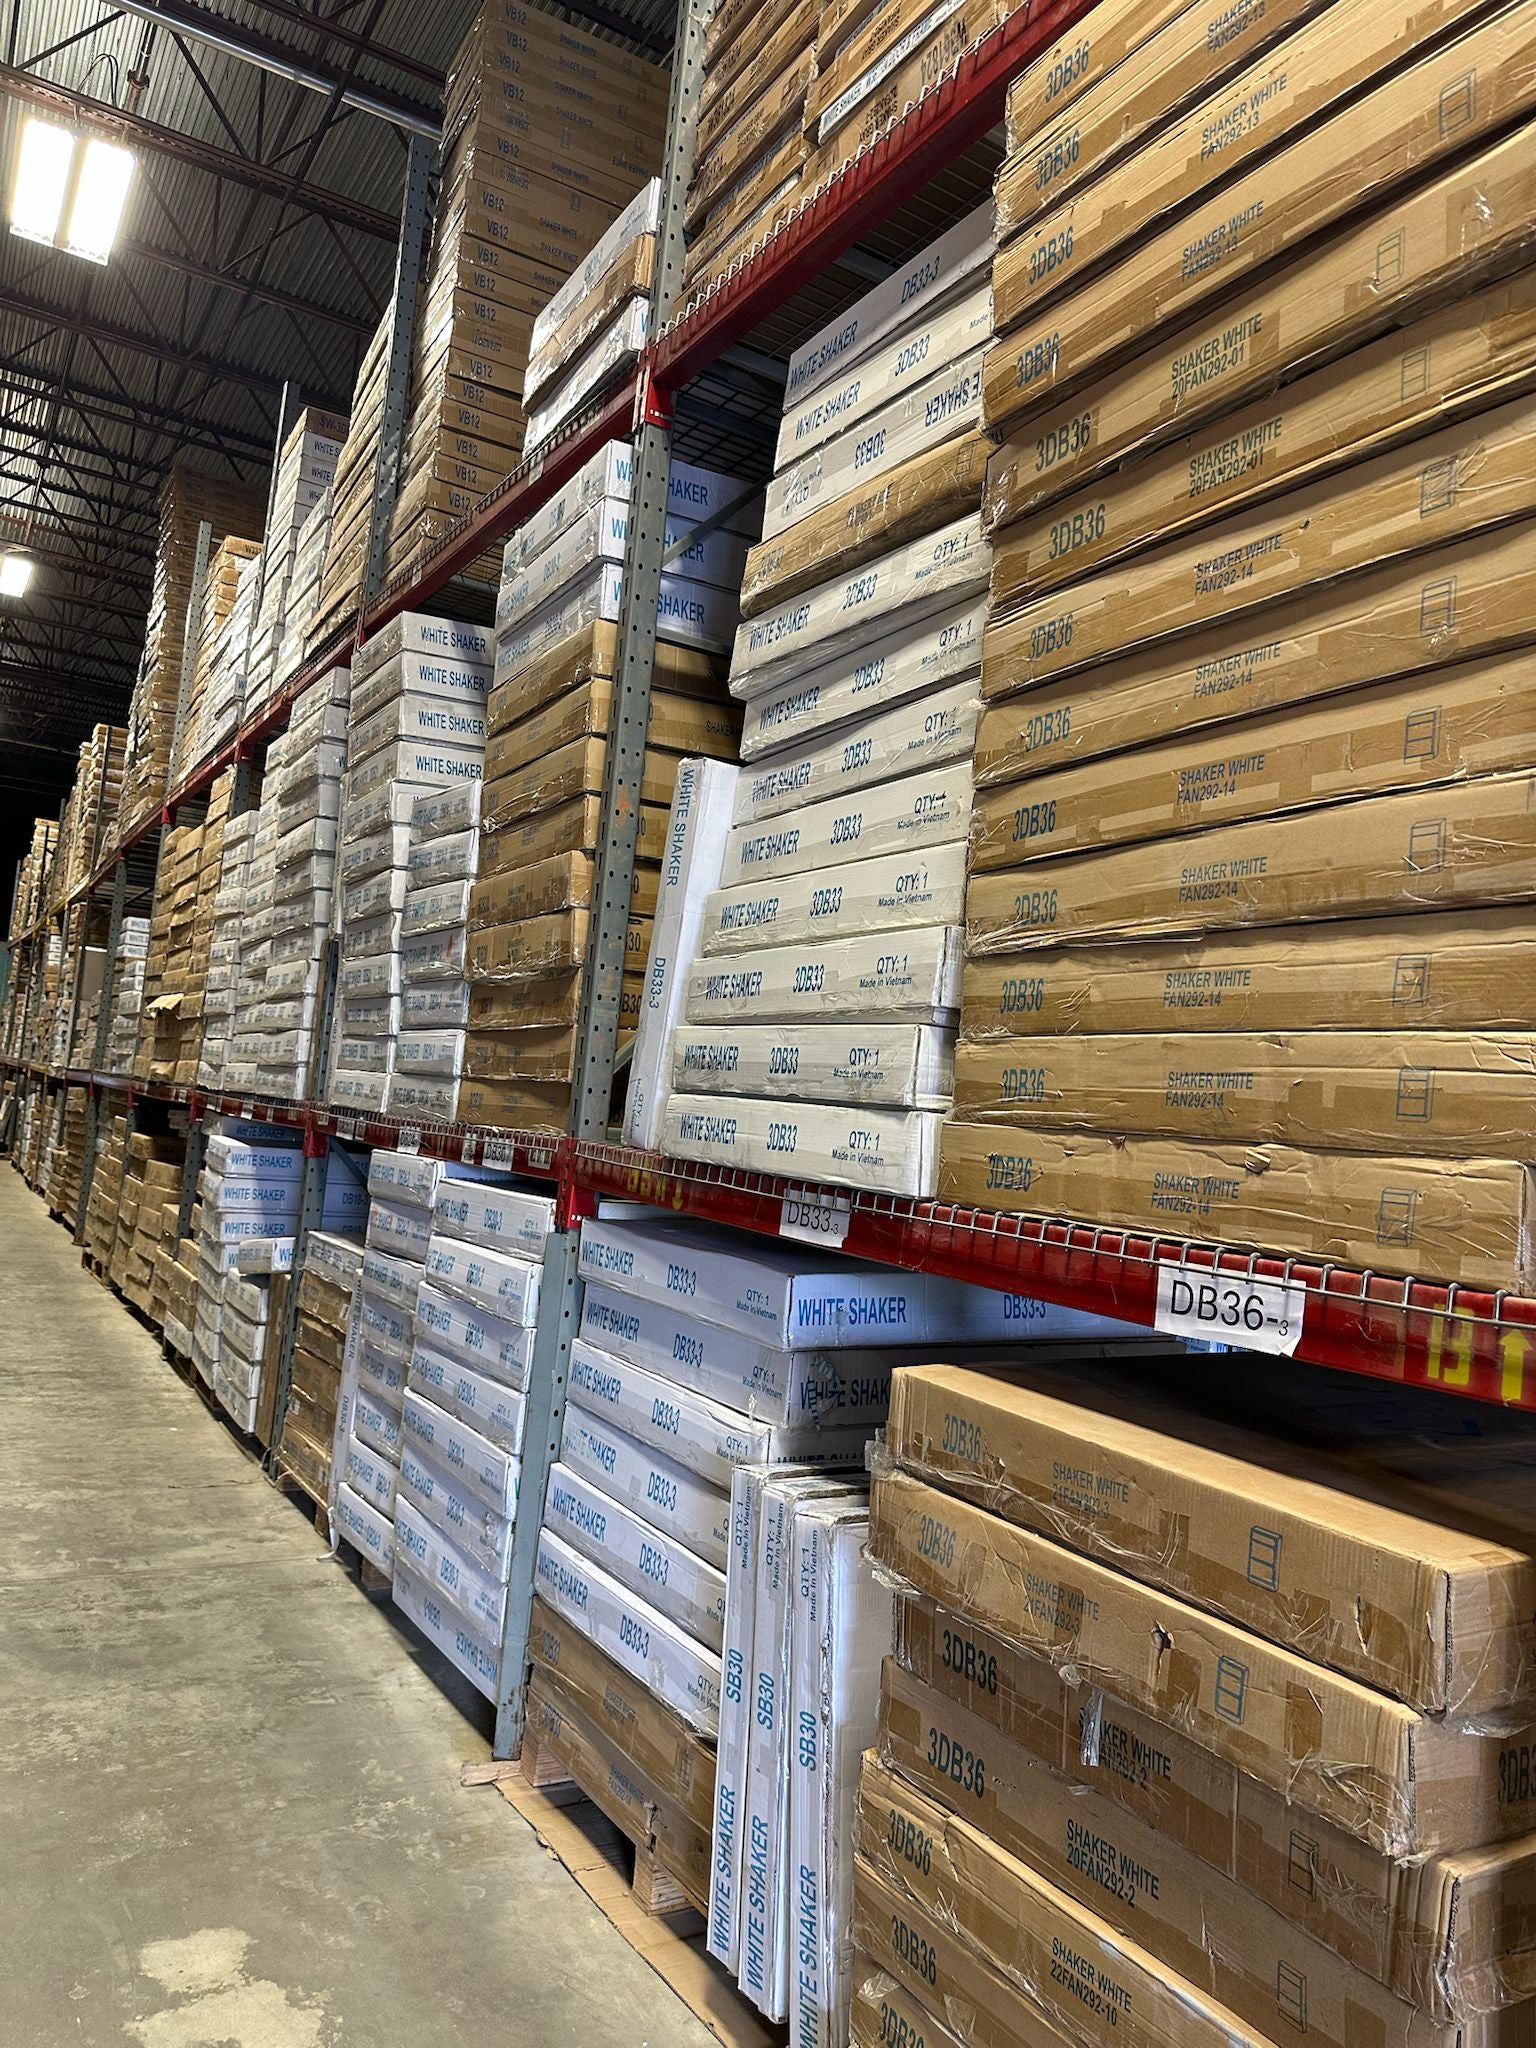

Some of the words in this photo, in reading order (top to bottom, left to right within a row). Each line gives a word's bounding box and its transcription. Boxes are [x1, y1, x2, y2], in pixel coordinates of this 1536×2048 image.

[505, 4, 528, 25] VB12
[1045, 41, 1090, 103] 3DB36
[502, 82, 525, 100] VB12
[1202, 103, 1247, 144] SHAKER
[1250, 74, 1287, 110] WHITE
[1200, 111, 1260, 161] FAN292-13
[487, 220, 509, 240] VB12
[477, 246, 499, 265] VB12
[1029, 226, 1074, 285] 3DB36
[473, 272, 496, 293] VB12
[901, 255, 940, 305] DB33-3
[790, 351, 819, 389] WHITE
[819, 320, 858, 370] SHAKER
[894, 334, 930, 377] 3DB33
[1172, 338, 1220, 379] SHAKER
[1223, 312, 1262, 350] WHITE
[470, 360, 493, 378] VB12
[463, 384, 485, 403] VB12
[314, 440, 334, 456] WHITE
[456, 439, 478, 457] VB12
[1035, 412, 1092, 472] 3DB36
[1189, 440, 1239, 478] SHAKER
[1241, 417, 1283, 452] WHITE
[1189, 449, 1265, 498] 20FAN292-01
[1049, 503, 1106, 559] 3DB36
[1196, 547, 1244, 579] SHAKER
[1245, 533, 1282, 560] WHITE
[1195, 563, 1254, 596] FAN292-14
[420, 626, 448, 646] WHITE
[450, 632, 486, 653] SHAKER
[419, 665, 446, 684] WHITE
[449, 671, 485, 692] SHAKER
[1194, 669, 1253, 700] FAN292-14
[418, 711, 446, 729] WHITE
[448, 716, 484, 736] SHAKER
[1026, 705, 1071, 753] 3DB36
[415, 755, 444, 774] WHITE
[446, 759, 482, 779] SHAKER
[1178, 761, 1225, 786] SHAKER
[1228, 754, 1265, 776] WHITE
[676, 769, 694, 819] WHITE
[830, 813, 862, 845] 3DB33
[1012, 800, 1057, 842] 3DB36
[666, 823, 686, 886] SHAKER
[1180, 861, 1227, 885] SHAKER
[1230, 856, 1268, 878] WHITE
[809, 886, 843, 917] 3DB33
[1178, 881, 1238, 904] FAN292-14
[721, 905, 745, 929] WHITE
[746, 897, 779, 926] SHAKER
[649, 957, 666, 1010] DB33-3
[792, 964, 825, 993] 3DB33
[859, 978, 876, 988] Made
[885, 975, 912, 987] Vietnam
[876, 957, 900, 975] QTY:
[1165, 971, 1210, 989] SHAKER
[1213, 970, 1251, 987] WHITE
[706, 976, 730, 999] WHITE
[731, 971, 763, 998] SHAKER
[1000, 978, 1045, 1014] 3DB36
[684, 1045, 706, 1069] WHITE
[707, 1045, 739, 1072] SHAKER
[769, 1047, 799, 1075] 3DB33
[1000, 1068, 1045, 1103] 3DB36
[1167, 1071, 1213, 1089] SHAKER
[1216, 1072, 1254, 1091] WHITE
[1165, 1091, 1225, 1109] FAN292-14
[680, 1114, 704, 1139] WHITE
[705, 1117, 737, 1145] SHAKER
[767, 1123, 798, 1153] 3DB33
[848, 1130, 871, 1150] QTY:
[232, 1153, 257, 1167] WHITE
[258, 1154, 292, 1169] SHAKER
[832, 1149, 848, 1161] Made
[857, 1153, 884, 1166] Vietnam
[224, 1187, 250, 1200] WHITE
[251, 1187, 286, 1201] SHAKER
[224, 1222, 250, 1235] WHITE
[251, 1222, 285, 1235] SHAKER
[787, 1203, 839, 1235] DB33-3
[582, 1240, 604, 1262] WHITE
[604, 1246, 634, 1276] SHAKER
[667, 1263, 696, 1296] DB33-3
[747, 1289, 764, 1304] QTY:
[586, 1301, 608, 1324] WHITE
[609, 1310, 640, 1342] SHAKER
[848, 1296, 907, 1325] SHAKER
[1170, 1280, 1289, 1336] DB36-3
[673, 1333, 704, 1368] DB33-3
[753, 1365, 769, 1382] QTY:
[850, 1376, 890, 1406] SHAK
[652, 1398, 680, 1435] DB33-3
[942, 1413, 982, 1463] 3DB36
[647, 1472, 677, 1512] DB33-3
[1052, 1462, 1093, 1489] SHAKER
[1096, 1476, 1129, 1503] WHITE
[553, 1486, 575, 1519] WHITE
[575, 1500, 606, 1542] SHAKER
[743, 1486, 751, 1527] Vietnam
[735, 1513, 744, 1546] QTY:
[917, 1515, 956, 1568] 3DB36
[639, 1543, 670, 1586] DB33-3
[801, 1560, 809, 1597] QTY:
[1023, 1596, 1080, 1635] 21FAN292-3
[1025, 1573, 1064, 1604] SHAKER
[1067, 1590, 1100, 1621] WHITE
[619, 1614, 650, 1659] DB33-3
[726, 1648, 744, 1703] SB30
[941, 1629, 998, 1696] 3DB36
[757, 1672, 775, 1731] SB30
[800, 1711, 817, 1772] SB30
[1131, 1736, 1171, 1781] WHITE
[928, 1727, 985, 1798] 3DB36
[716, 1784, 736, 1879] SHAKER
[887, 1809, 932, 1876] 3DB36
[749, 1815, 769, 1914] SHAKER
[1066, 1843, 1135, 1908] 20FAN292-2
[1067, 1818, 1117, 1865] SHAKER
[1120, 1853, 1159, 1900] WHITE
[713, 1878, 731, 1952] WHITE
[799, 1864, 817, 1971] SHAKER
[747, 1911, 764, 1991] WHITE
[891, 1914, 936, 1986] 3DB36
[1052, 1936, 1095, 1983] SHAKER
[1097, 1971, 1132, 2013] WHITE
[799, 1970, 818, 2048] WHITE
[1050, 1961, 1117, 2026] 22FAN292-10
